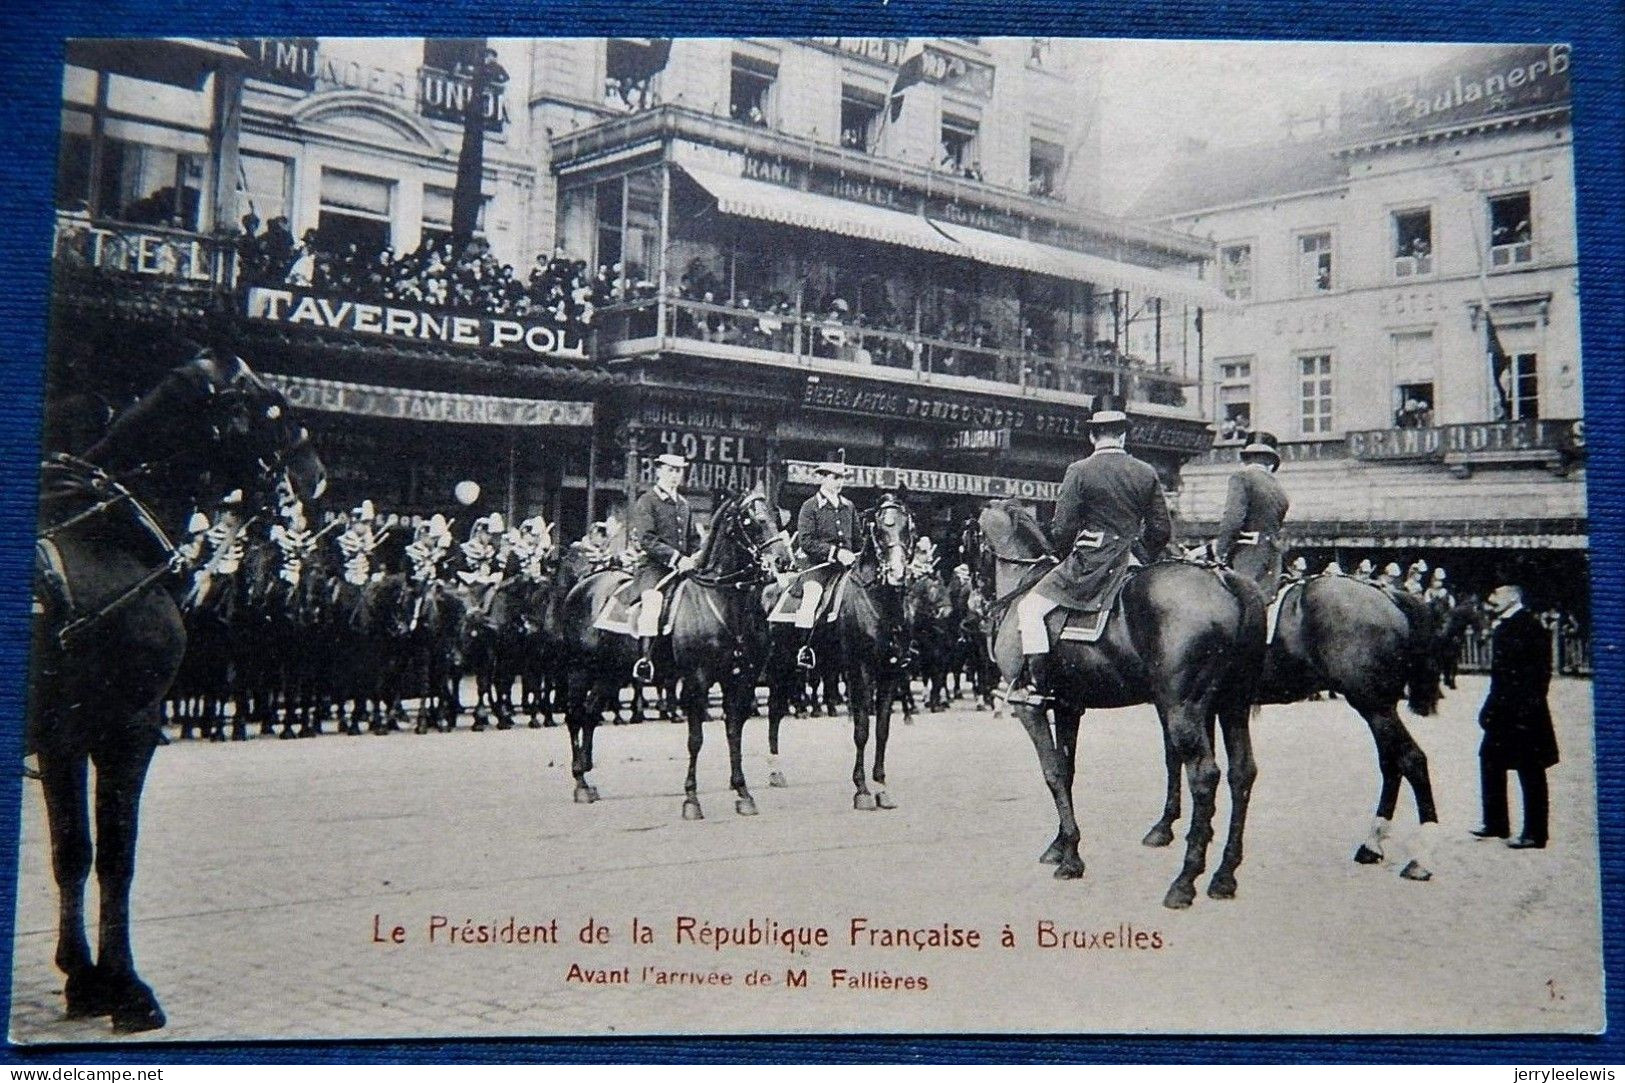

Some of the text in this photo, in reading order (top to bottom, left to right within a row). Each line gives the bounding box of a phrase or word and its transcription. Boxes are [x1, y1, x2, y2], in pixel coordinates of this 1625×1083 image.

[257, 287, 480, 345] TAVERNE
[1351, 428, 1440, 456] GRAND
[894, 469, 991, 495] RESTAURANT
